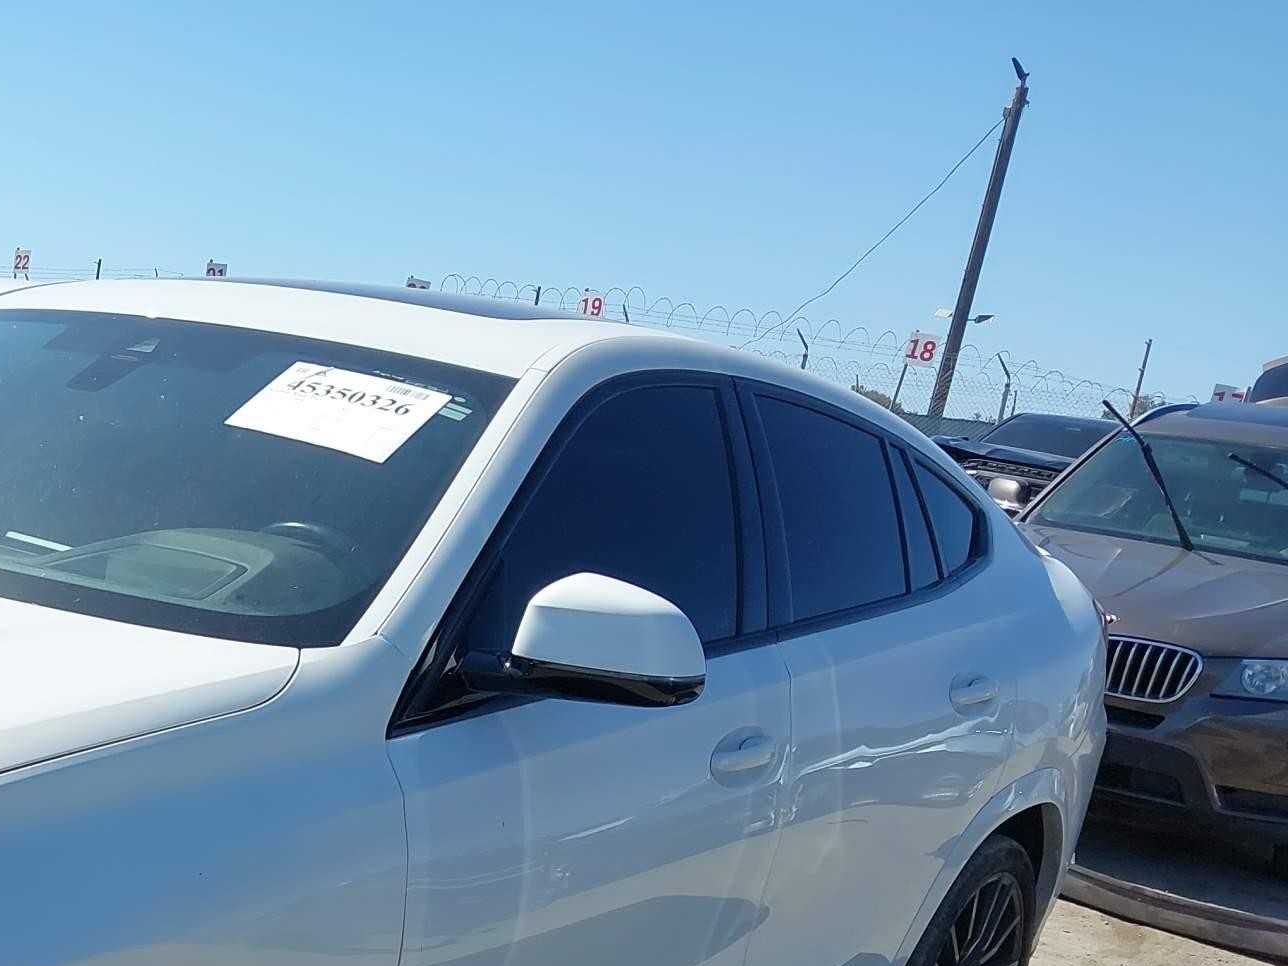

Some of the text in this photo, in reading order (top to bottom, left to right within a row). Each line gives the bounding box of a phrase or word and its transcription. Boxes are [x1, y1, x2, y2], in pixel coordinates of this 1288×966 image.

[14, 254, 30, 270] 22
[581, 297, 603, 317] 19
[905, 338, 937, 362] 18
[287, 379, 416, 416] 45350326
